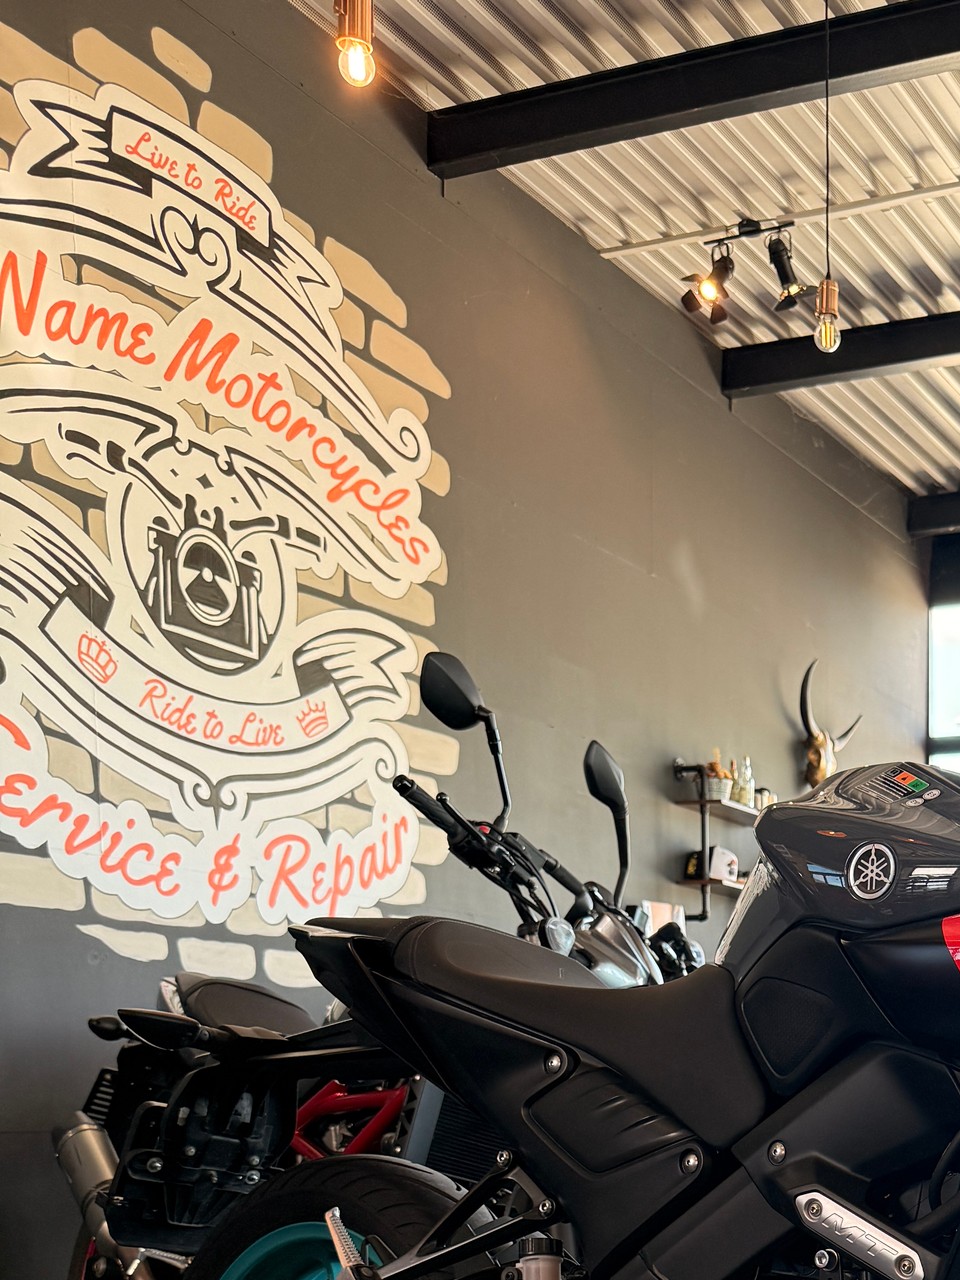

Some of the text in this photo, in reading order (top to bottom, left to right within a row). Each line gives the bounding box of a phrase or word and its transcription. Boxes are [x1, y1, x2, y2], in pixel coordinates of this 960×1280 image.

[125, 131, 258, 232] Live to Ride
[0, 248, 430, 566] Name Motorcycles
[139, 678, 285, 747] Ride to Live
[207, 833, 241, 907] &
[263, 815, 408, 918] Repair
[821, 1212, 899, 1257] MT
